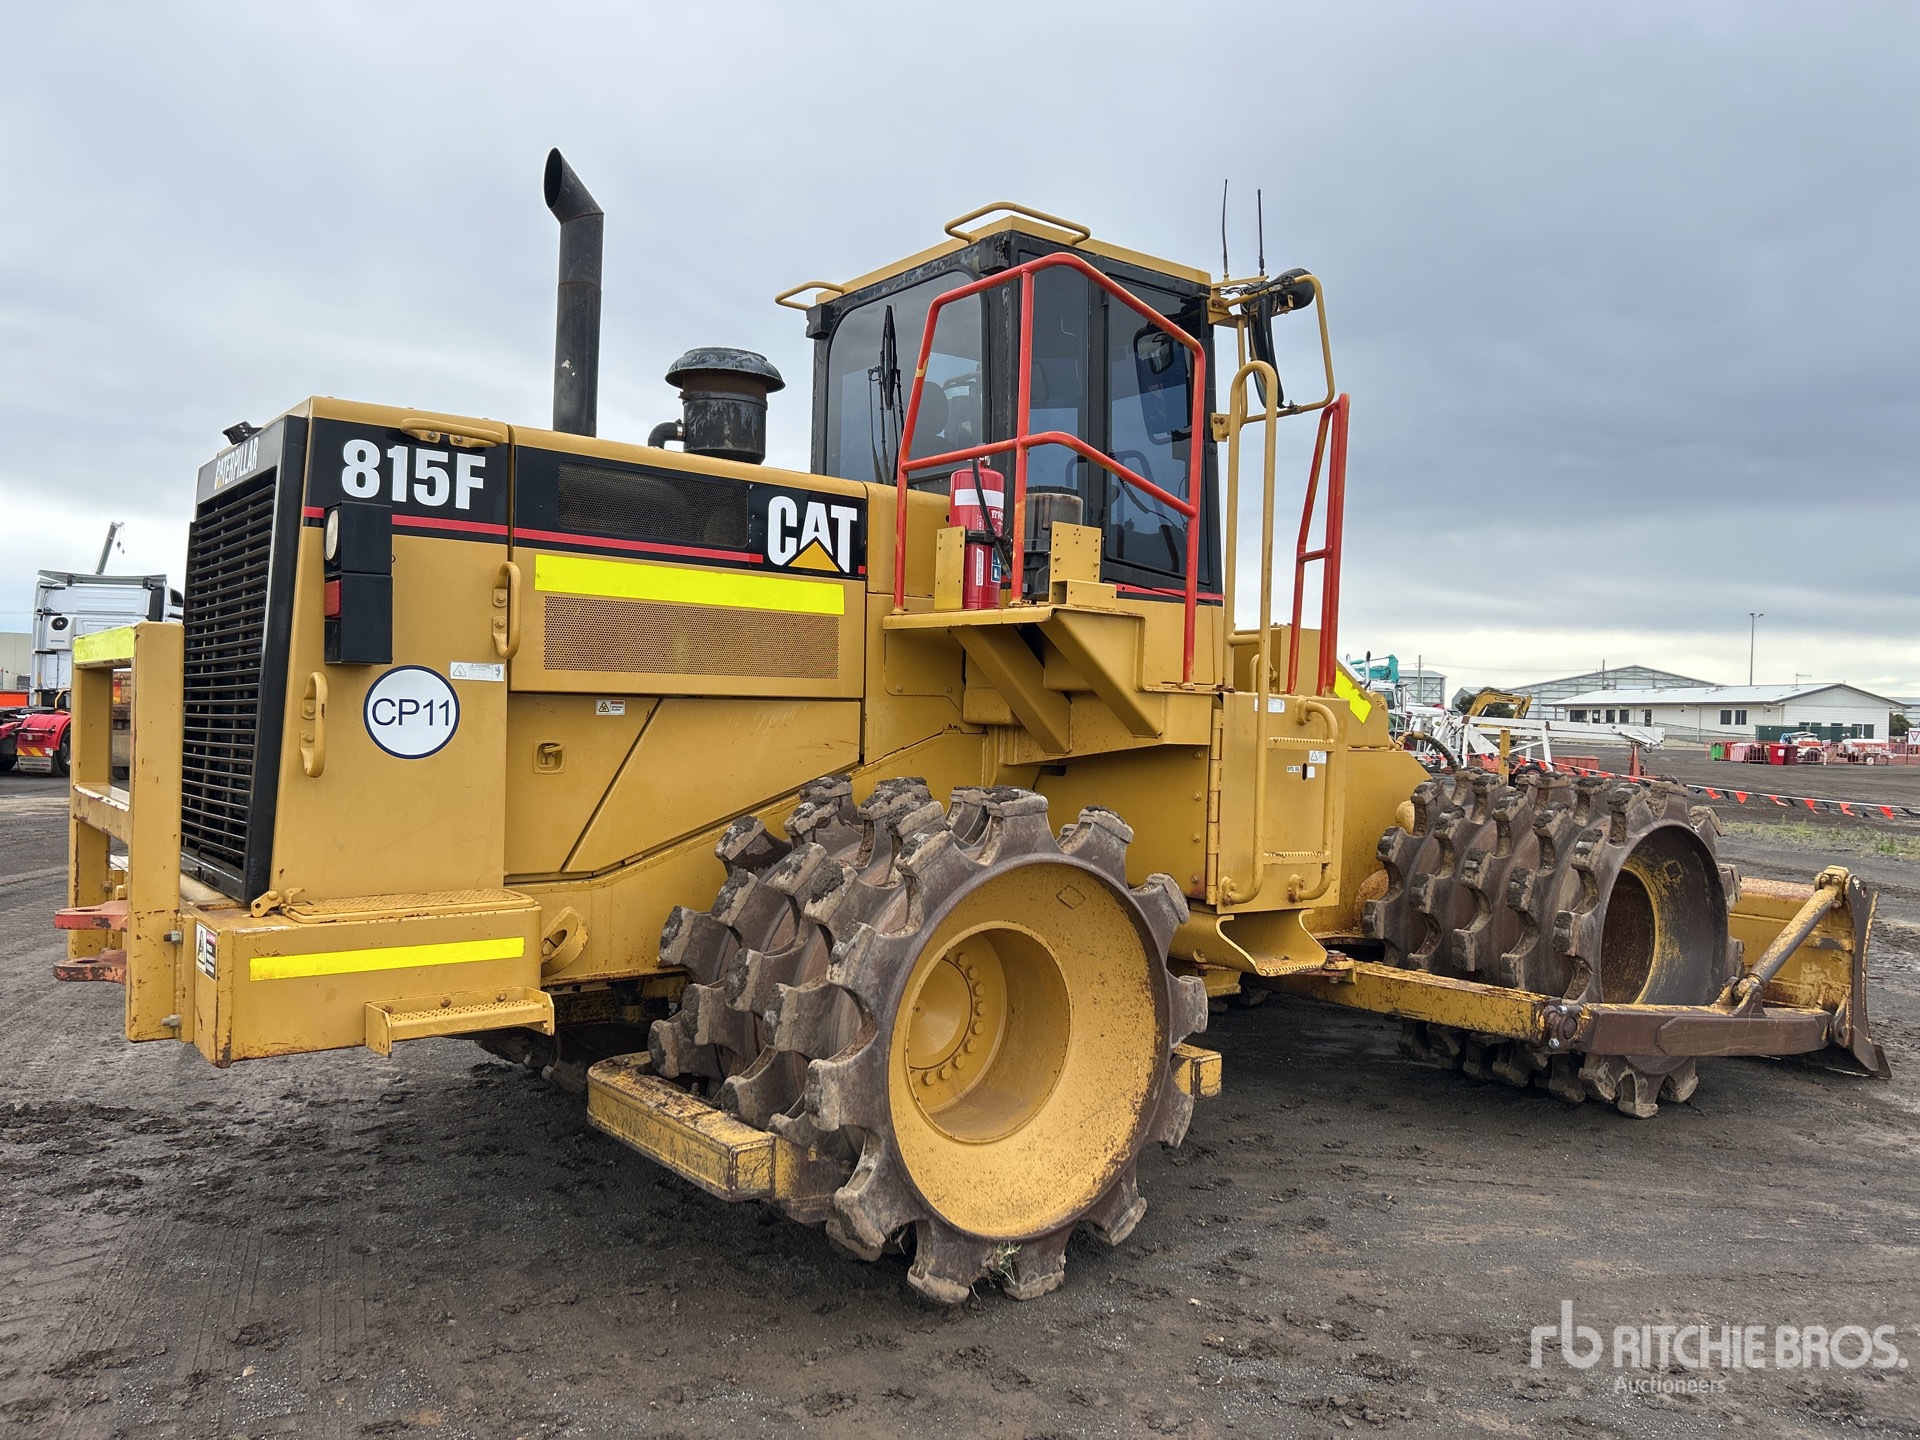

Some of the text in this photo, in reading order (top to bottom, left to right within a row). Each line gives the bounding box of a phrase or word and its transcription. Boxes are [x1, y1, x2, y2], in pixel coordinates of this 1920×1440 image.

[213, 436, 259, 490] CATERPILLAR
[341, 438, 486, 510] 815F
[767, 495, 858, 574] CAT
[371, 698, 450, 727] CP11
